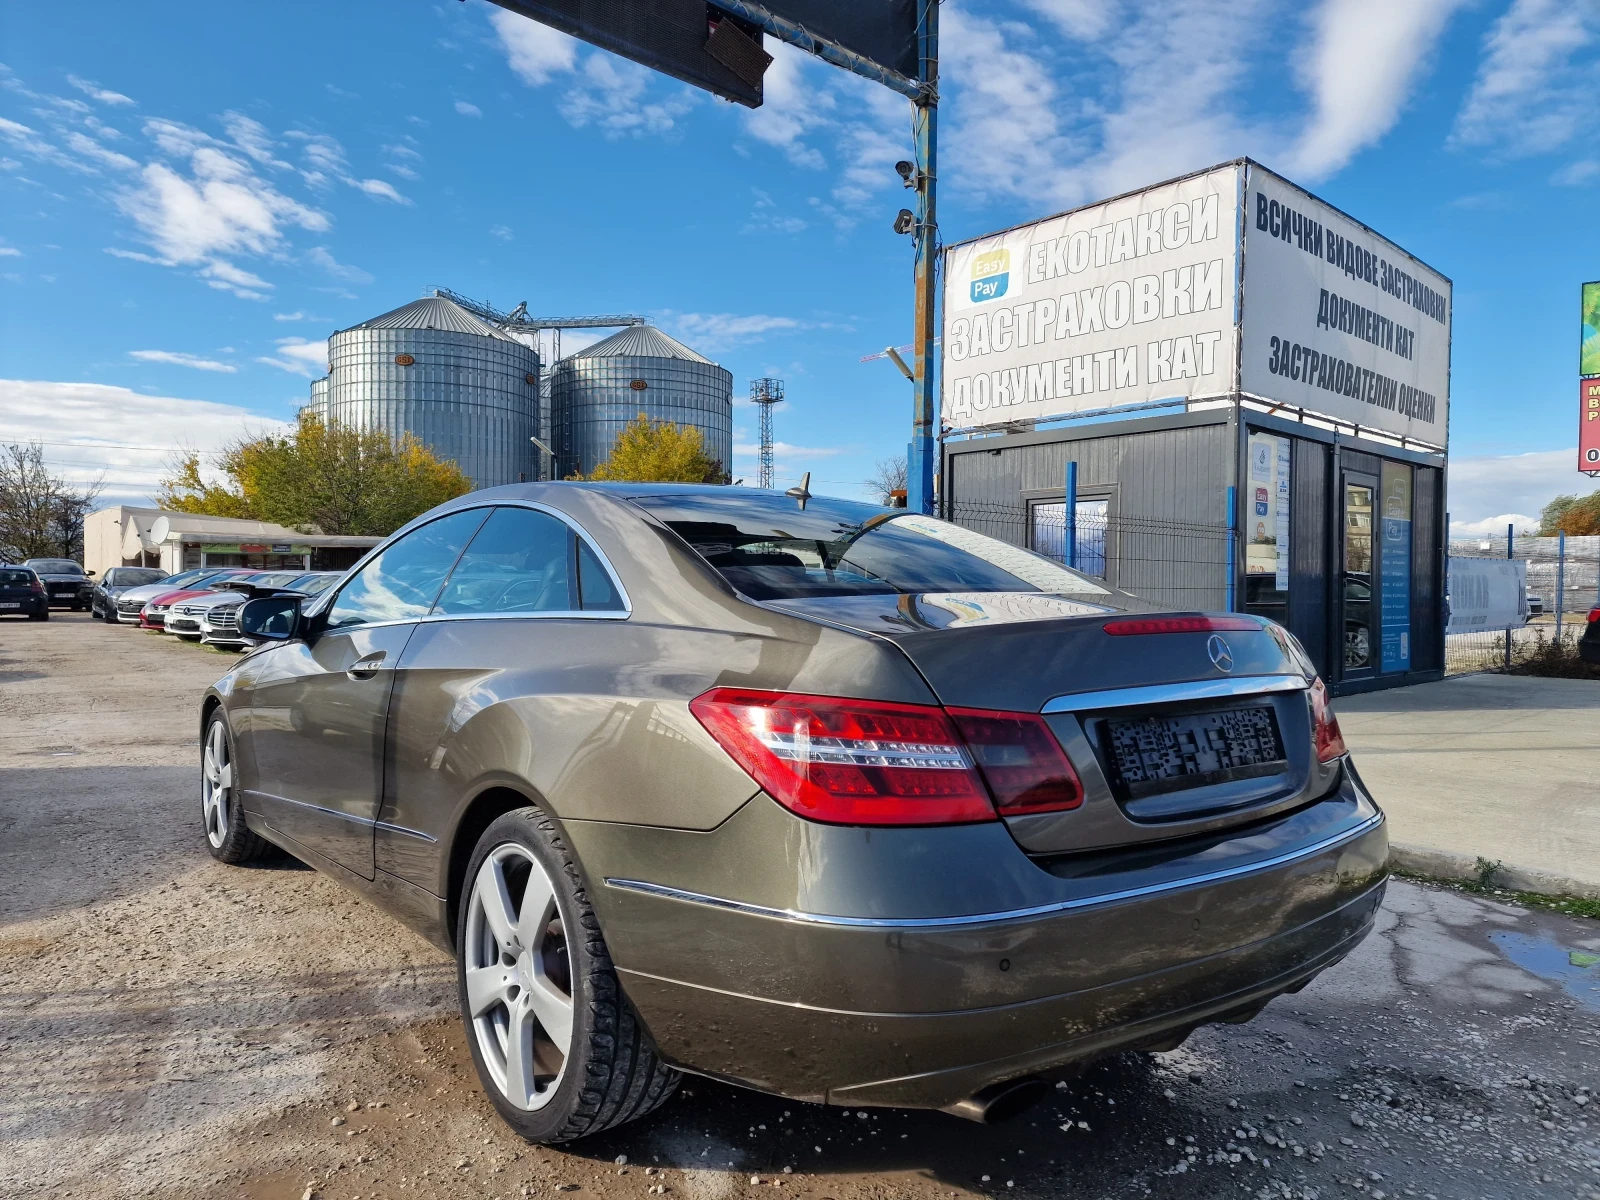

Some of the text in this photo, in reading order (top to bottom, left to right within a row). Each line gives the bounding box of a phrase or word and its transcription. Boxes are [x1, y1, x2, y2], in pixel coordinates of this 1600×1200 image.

[975, 256, 1006, 276] Easy
[1028, 193, 1219, 284] ЕКОТАКСИ
[1256, 192, 1446, 325] ВСИЧКИ ВИДОВЕ ЗАСТРАХОВКИ
[951, 259, 1223, 361] ЗАСТРАХОВКИ
[974, 280, 998, 297] Pay
[1317, 288, 1415, 361] ДОКУМЕНТИ КАТ
[950, 331, 1222, 420] ДОКУМЕНТИ КАТ
[1268, 335, 1436, 424] ЗАСТРАХОВАТЕЛНИ ОЦЕНКИ
